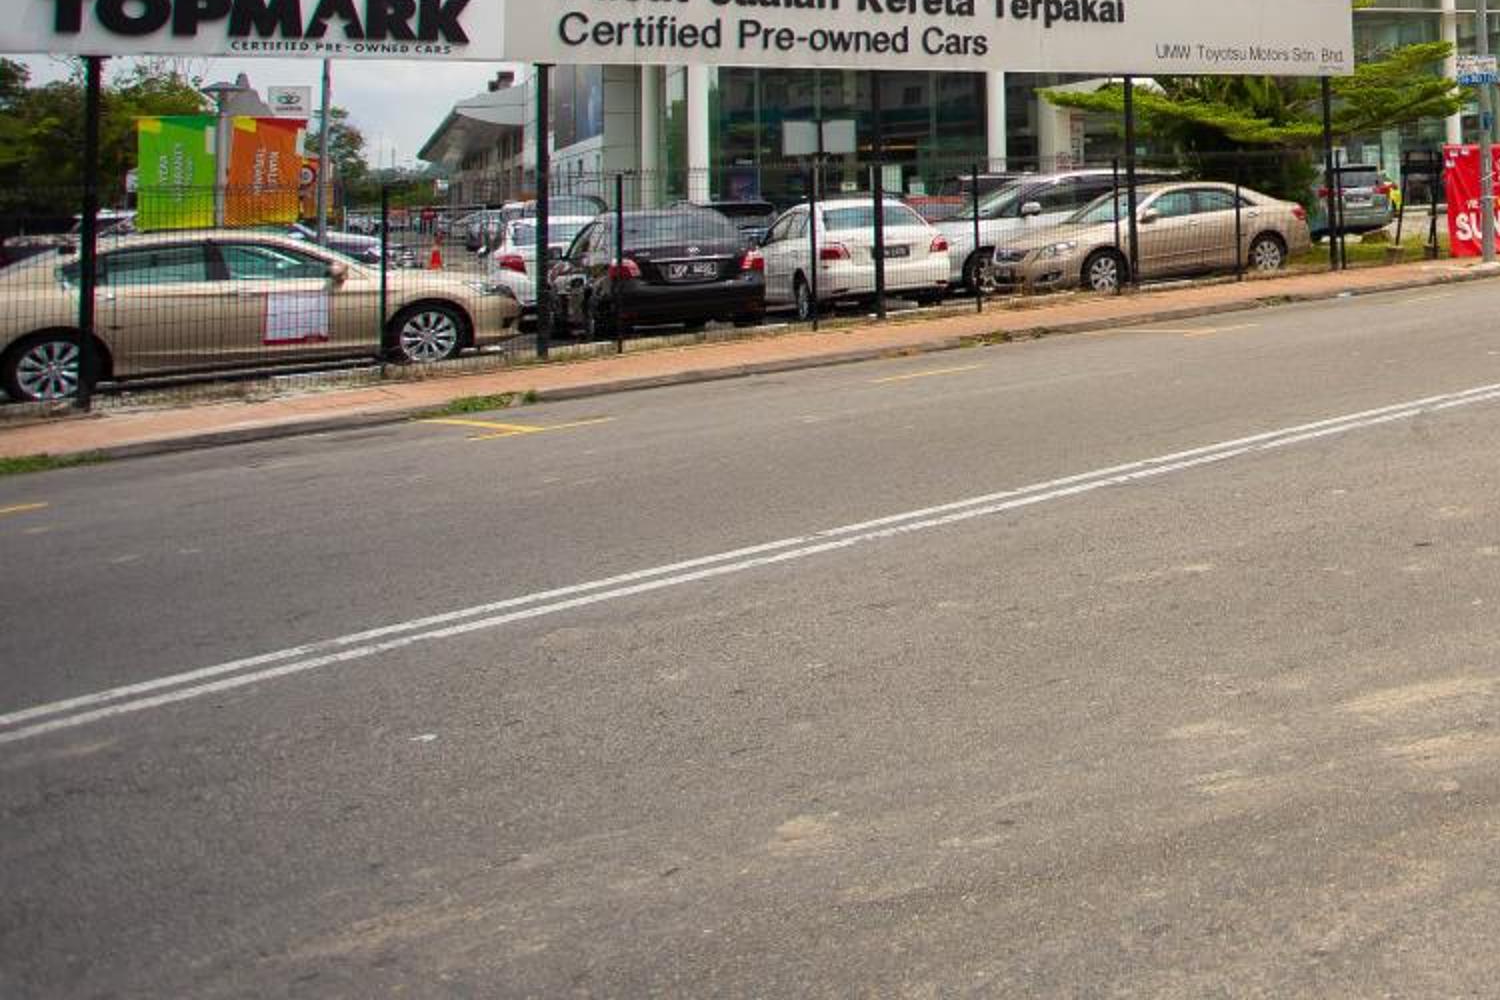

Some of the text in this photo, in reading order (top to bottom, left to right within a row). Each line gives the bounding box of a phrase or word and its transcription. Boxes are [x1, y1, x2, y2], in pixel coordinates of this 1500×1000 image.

[559, 12, 988, 56] Certified Pre-owned Cars
[231, 40, 452, 55] CERTIFIED PRE-OWNED CARS
[1155, 44, 1191, 60] UMW
[1199, 45, 1247, 64] Toyotsu
[1250, 46, 1289, 62] Motors
